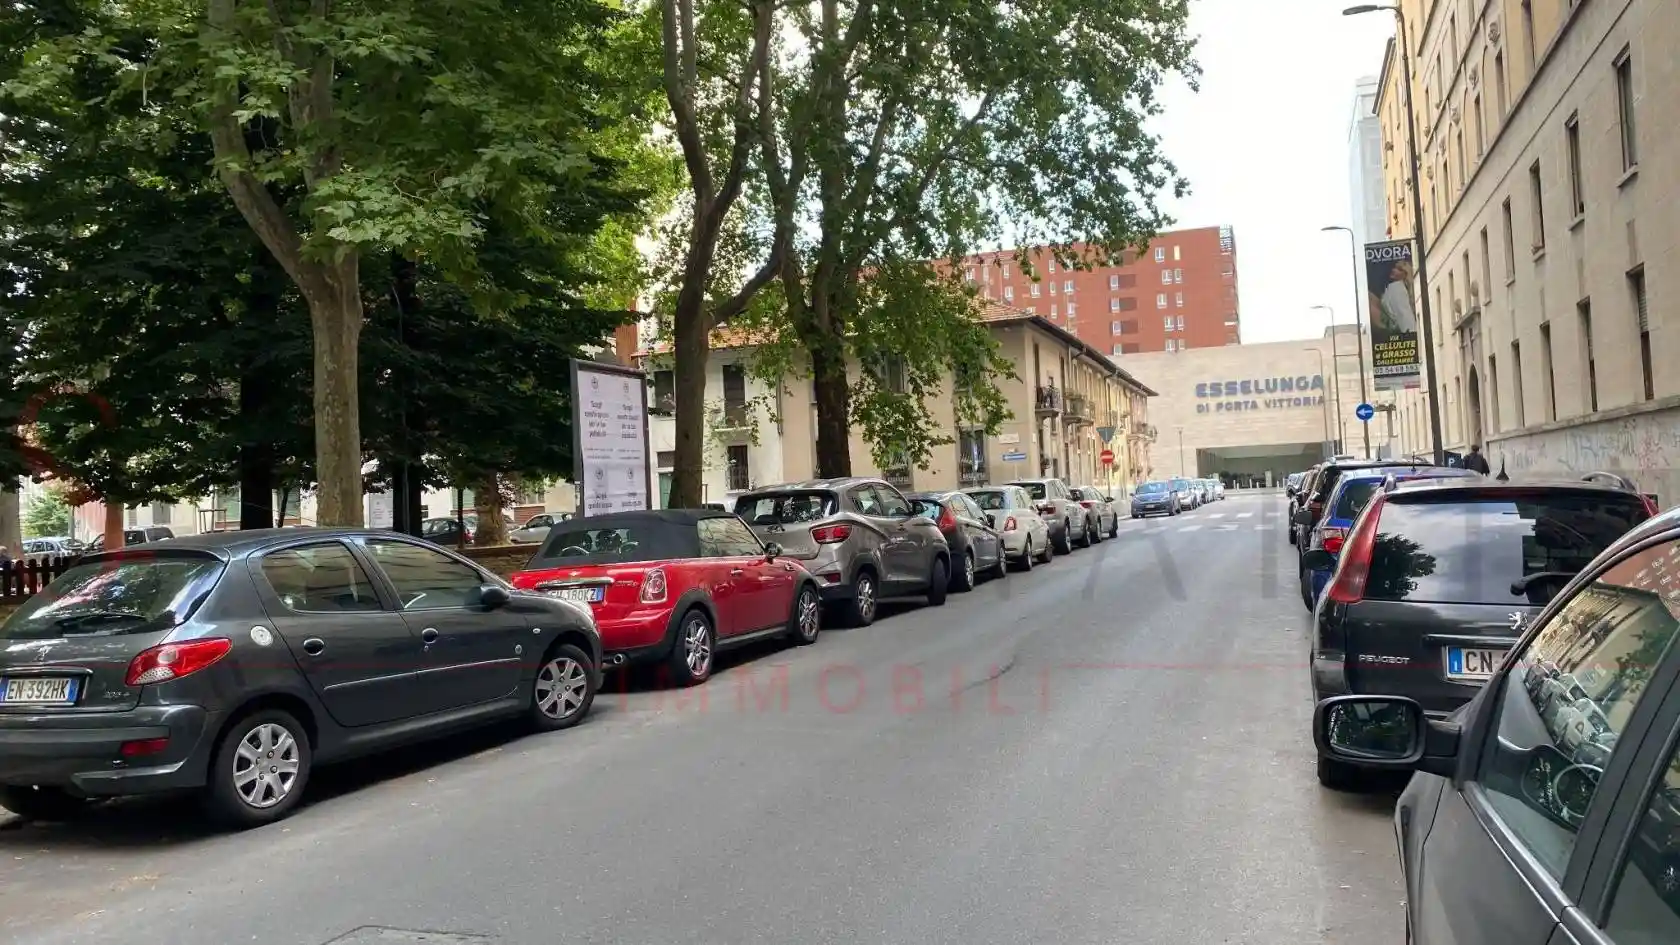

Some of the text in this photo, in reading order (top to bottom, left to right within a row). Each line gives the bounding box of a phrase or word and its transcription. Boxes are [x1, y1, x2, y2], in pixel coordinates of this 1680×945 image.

[1366, 245, 1410, 260] DVORA
[1374, 341, 1416, 351] CELLULITE
[1382, 349, 1416, 359] GRASSO
[1196, 375, 1323, 397] ESSELUNGA
[1197, 396, 1324, 413] DI PORTA VITTORIA
[1359, 654, 1410, 664] PEUGEOT
[1465, 651, 1494, 673] CN
